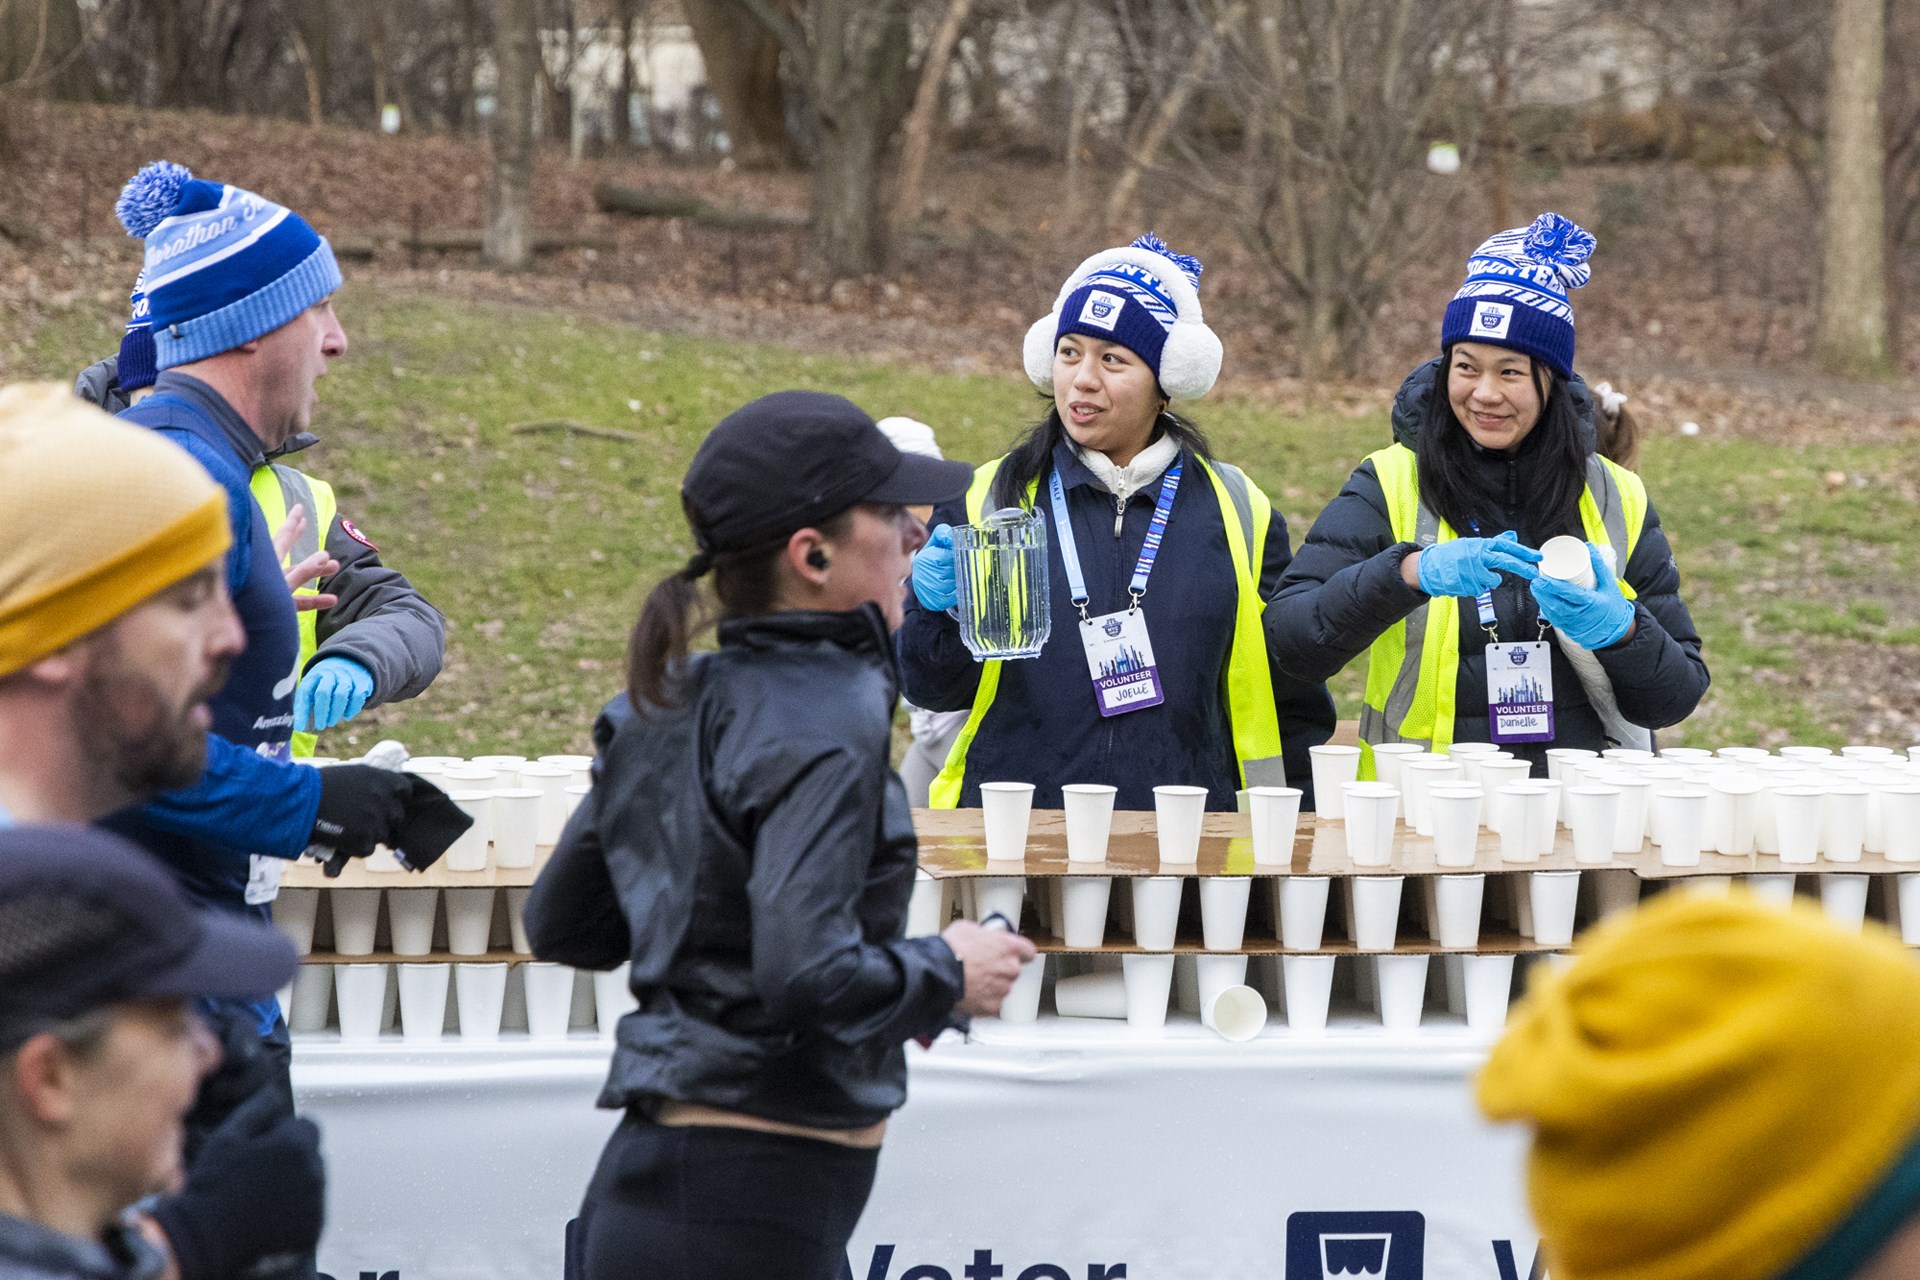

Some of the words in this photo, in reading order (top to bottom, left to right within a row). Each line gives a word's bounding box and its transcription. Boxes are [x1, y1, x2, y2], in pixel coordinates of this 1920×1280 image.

[1100, 670, 1152, 688] VOLUNTEER
[1496, 705, 1548, 714] VOLUNTEER
[1500, 716, 1538, 728] Danielle
